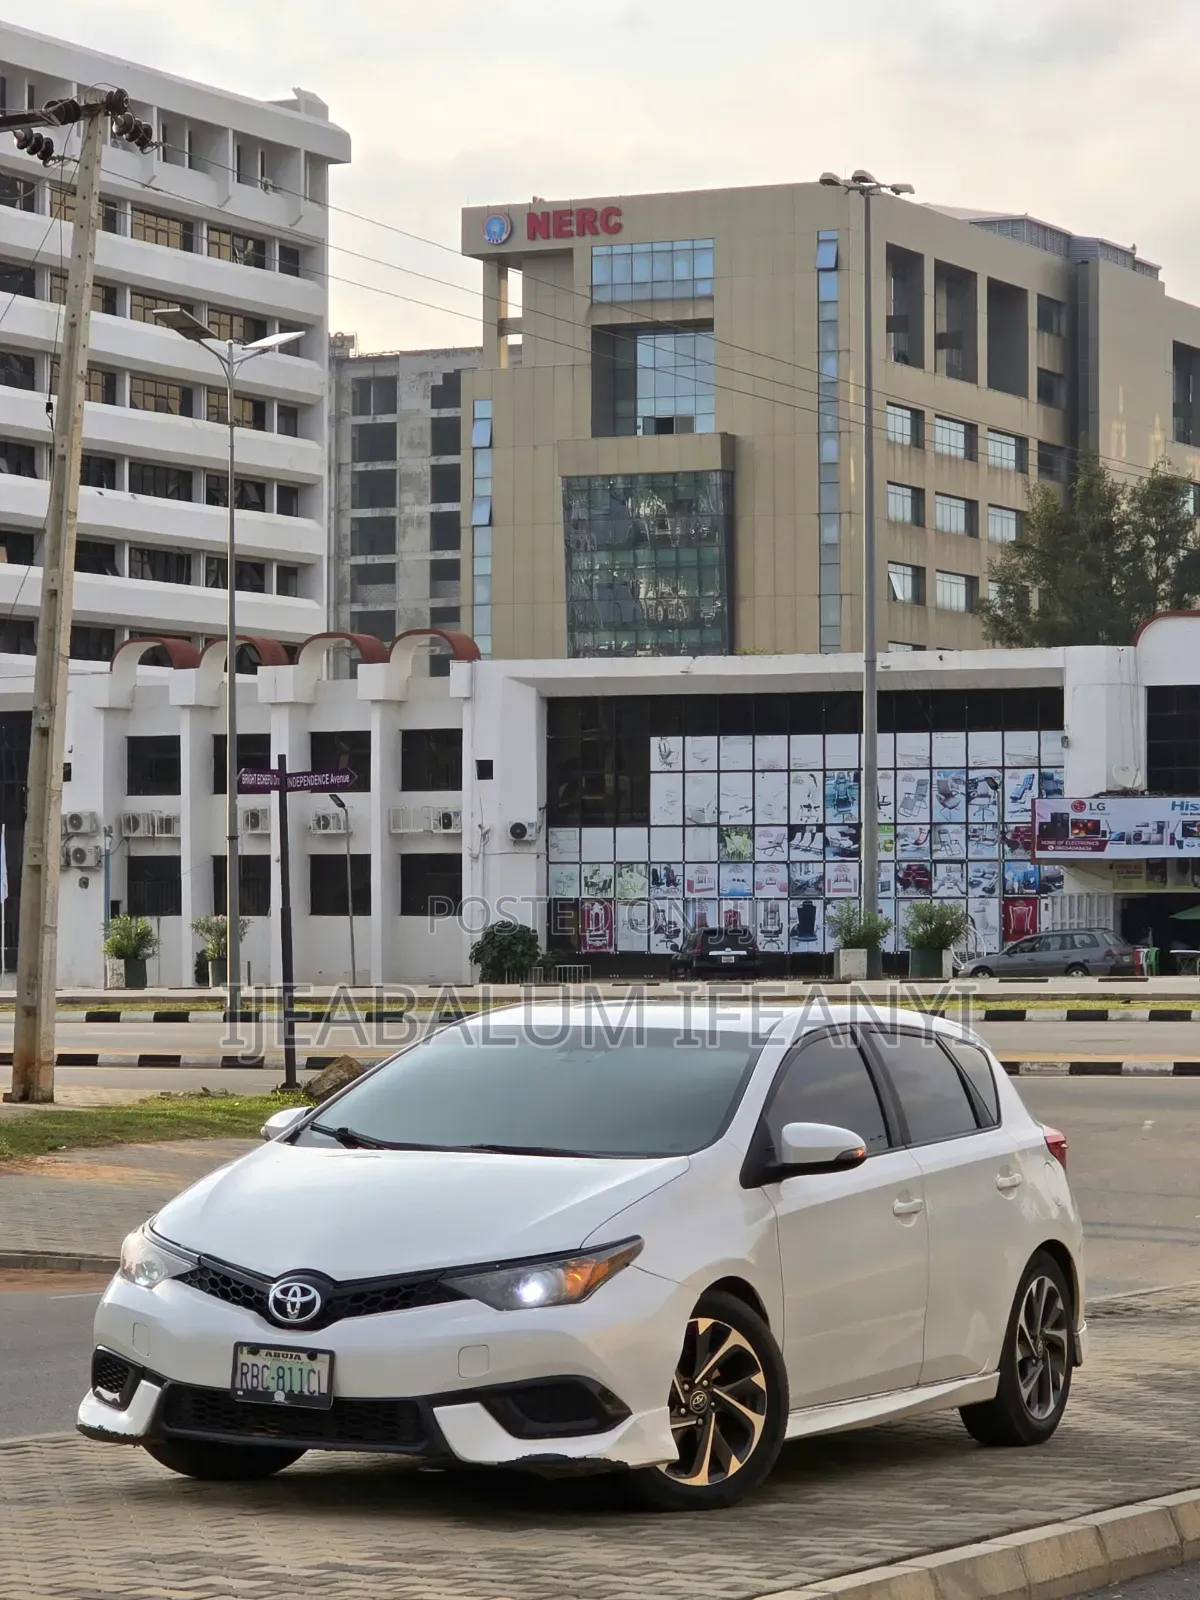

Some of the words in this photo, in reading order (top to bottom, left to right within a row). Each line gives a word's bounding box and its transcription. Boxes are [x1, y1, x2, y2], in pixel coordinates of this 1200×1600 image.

[527, 206, 623, 241] NERC
[287, 774, 330, 788] INDEPENDENCE
[330, 773, 350, 784] Avenue
[1089, 802, 1106, 811] LG
[264, 1350, 302, 1361] ABUJA
